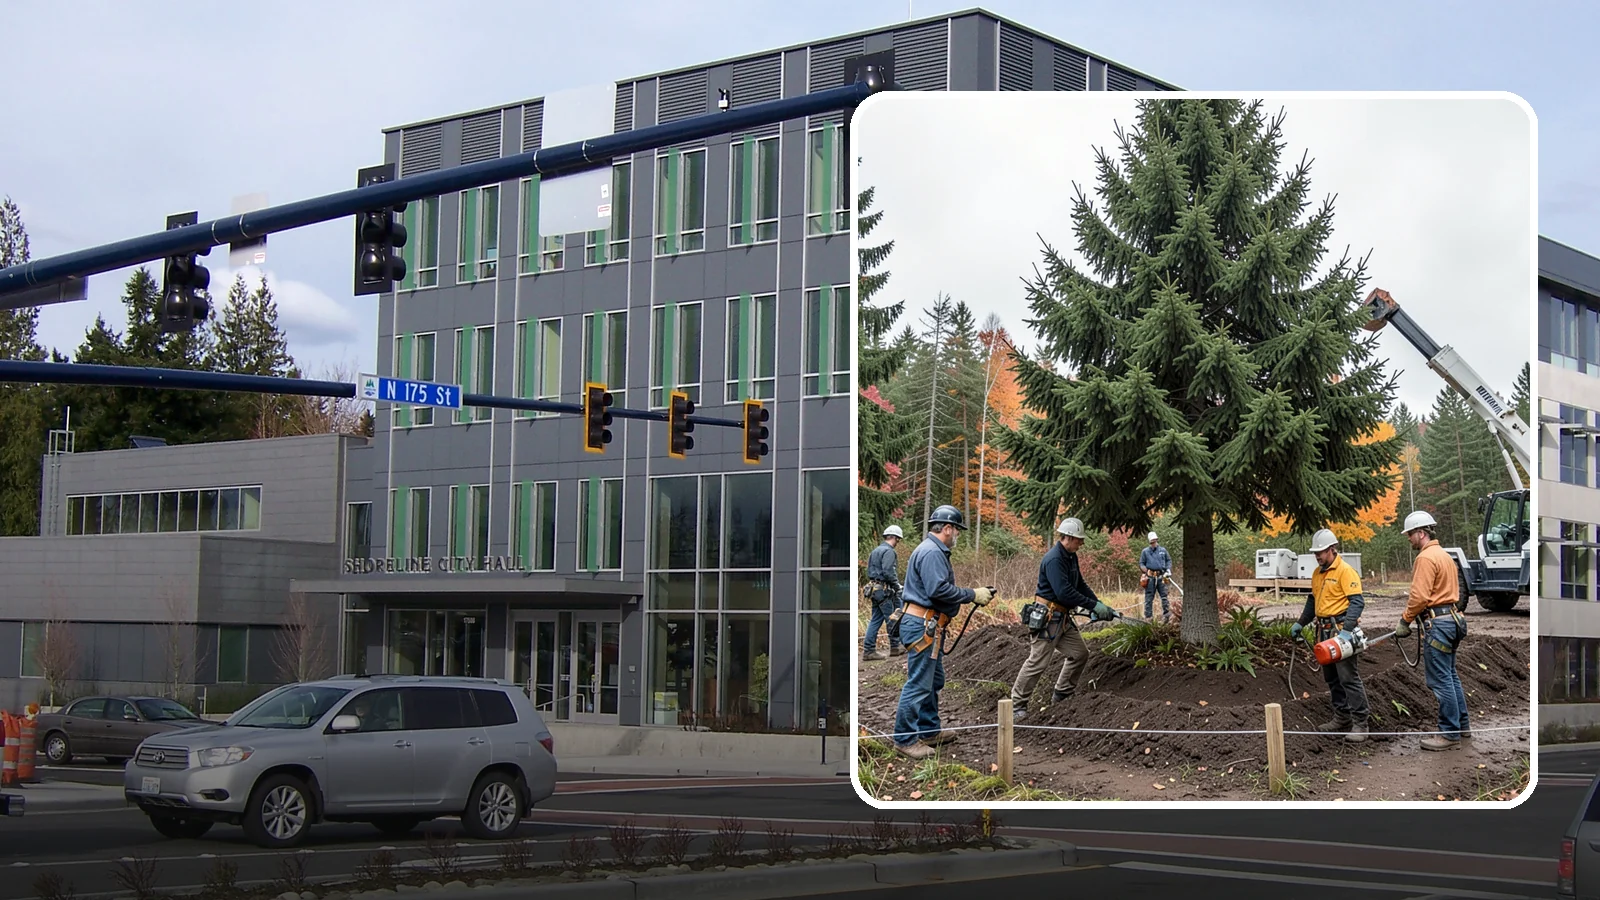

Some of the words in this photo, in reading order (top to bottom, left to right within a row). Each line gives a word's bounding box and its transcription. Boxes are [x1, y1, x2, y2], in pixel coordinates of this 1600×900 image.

[387, 380, 396, 400] N
[405, 382, 427, 403] 175
[436, 386, 451, 406] St
[344, 556, 432, 574] SHORELINE
[438, 556, 475, 572] CITY
[483, 555, 525, 572] HALL
